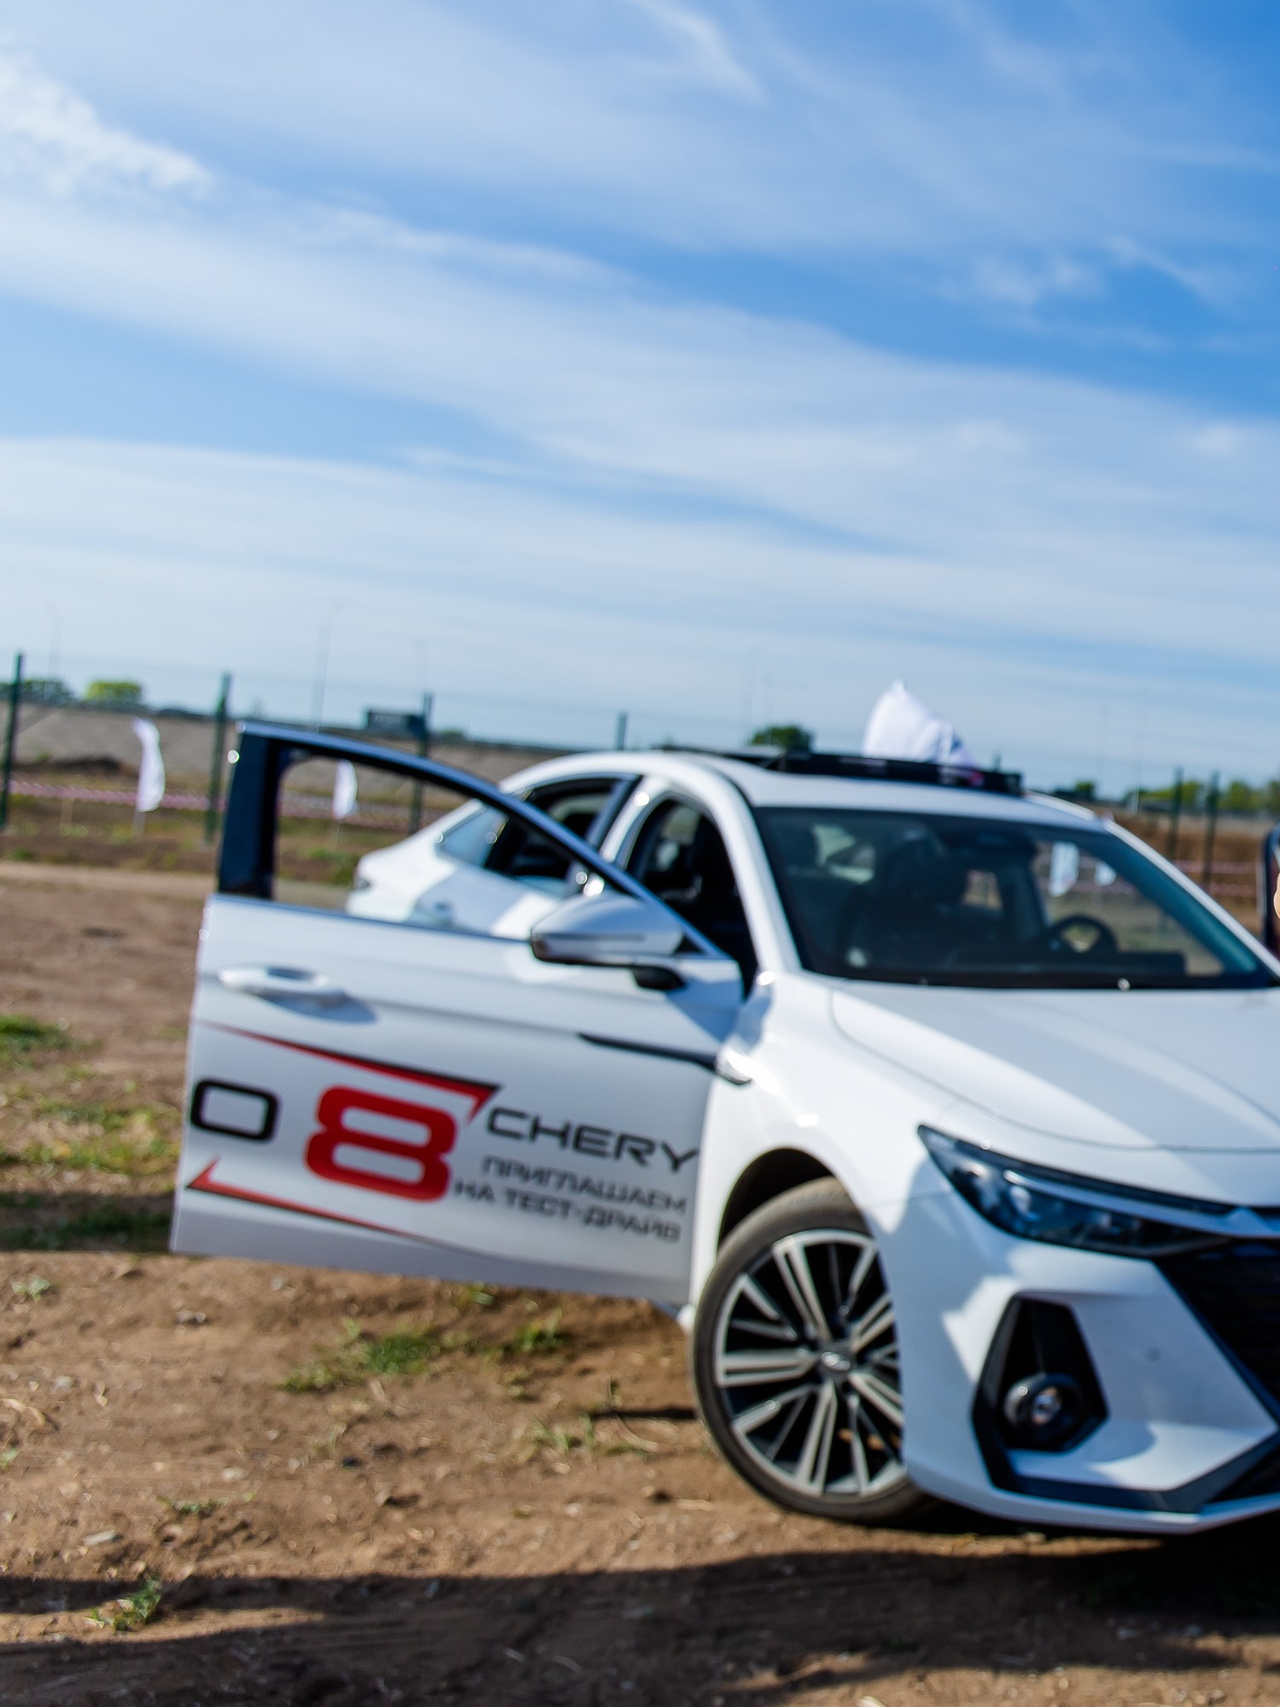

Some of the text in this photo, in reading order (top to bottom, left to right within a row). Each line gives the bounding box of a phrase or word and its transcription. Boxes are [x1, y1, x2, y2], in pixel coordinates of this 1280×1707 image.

[304, 1084, 457, 1204] 8
[486, 1106, 699, 1173] CHERY
[453, 1179, 496, 1203] НА
[482, 1154, 687, 1214] ПРИГЛАШАЕМ
